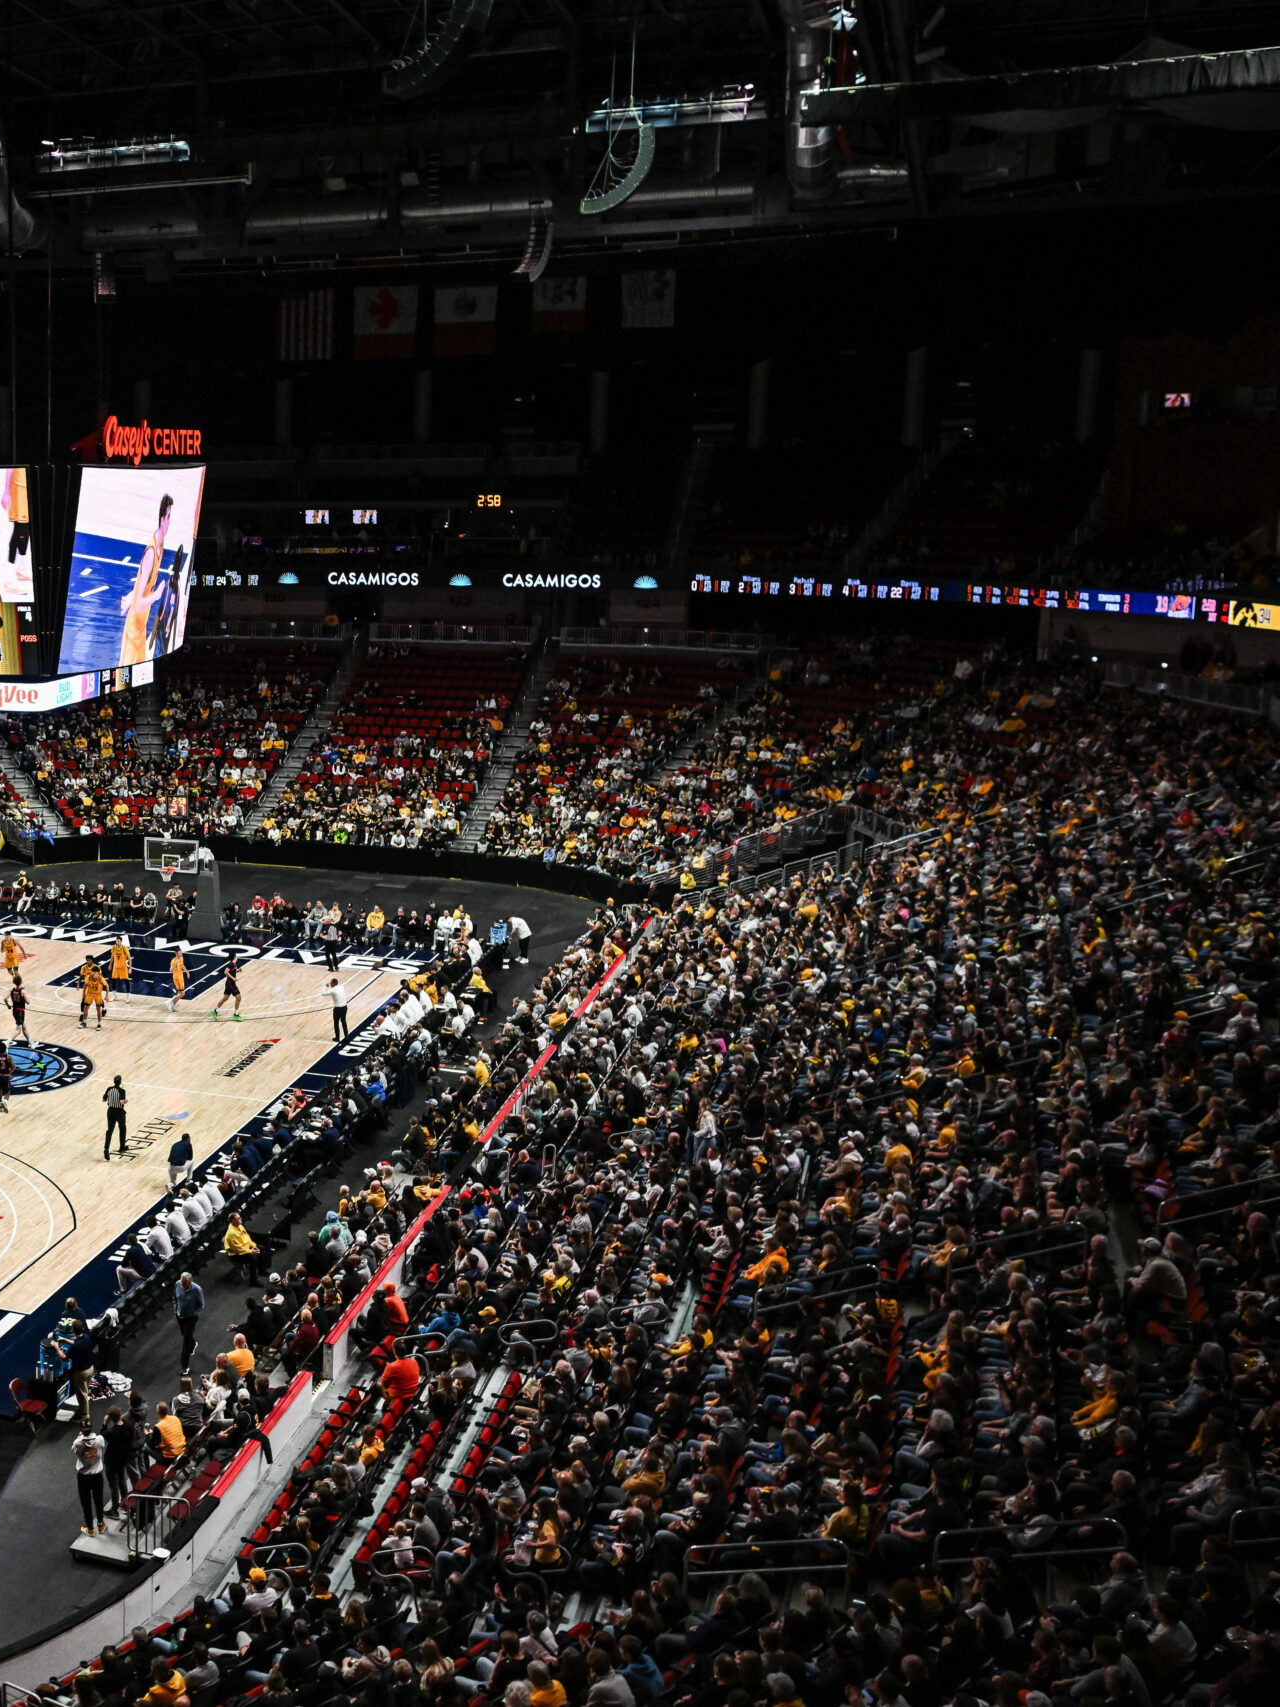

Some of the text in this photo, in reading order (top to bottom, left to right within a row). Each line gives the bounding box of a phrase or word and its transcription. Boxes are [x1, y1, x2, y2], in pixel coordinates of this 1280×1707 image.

[103, 415, 202, 466] Casey's CENTER
[476, 494, 502, 508] 2:58
[216, 576, 227, 587] 24
[326, 572, 420, 587] CASAMIGOS
[503, 573, 602, 589] CASAMIGOS
[890, 587, 903, 599] 22
[1155, 596, 1169, 613] 19
[25, 612, 33, 623] 4
[1257, 608, 1272, 624] 34
[19, 636, 38, 645] POSS
[58, 680, 71, 694] BUD
[56, 690, 73, 704] LIGHT
[153, 937, 427, 974] WOLVES
[27, 1055, 88, 1092] WOLVES
